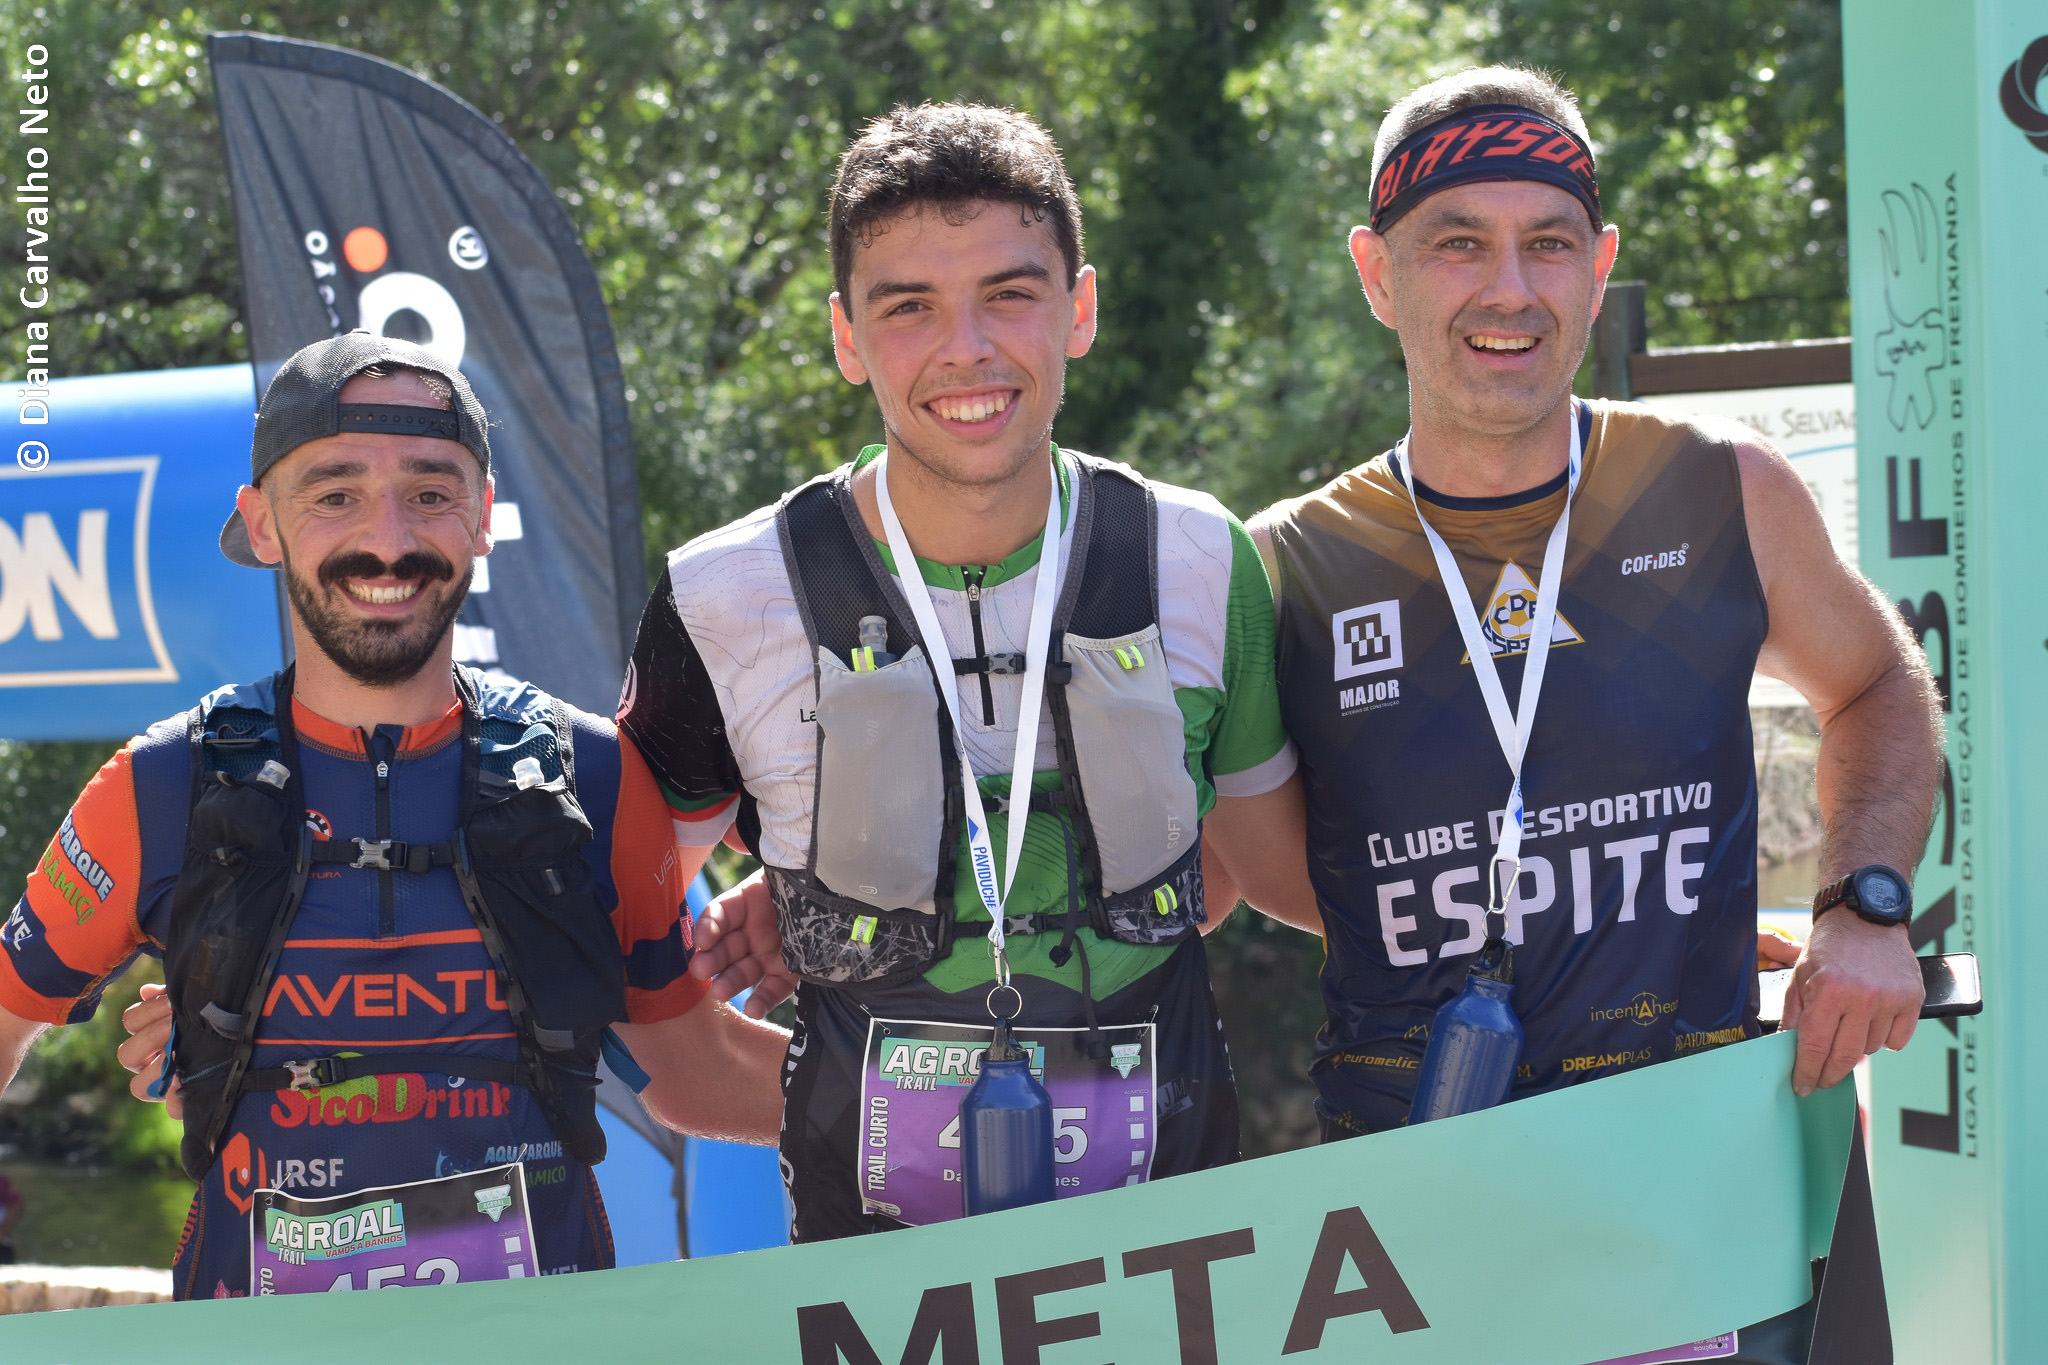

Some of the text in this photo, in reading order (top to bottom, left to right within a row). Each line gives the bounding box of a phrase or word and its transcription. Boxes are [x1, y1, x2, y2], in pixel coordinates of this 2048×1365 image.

[1944, 172, 1963, 366] FREIXIANDA
[1951, 378, 1965, 418] DE
[1951, 431, 1969, 626] BOMBEIROS
[1956, 637, 1970, 679] DE
[1340, 679, 1400, 710] MAJOR
[973, 846, 997, 909] PAVIDUCHE
[1961, 837, 1974, 881] DA
[1376, 826, 1711, 967] ESPITE
[1964, 1032, 1978, 1074] DE
[271, 1072, 511, 1127] SicoDrink
[895, 1074, 938, 1092] TRAIL
[867, 1096, 889, 1191] TRAIL CURTO
[1965, 1087, 1978, 1158] LIGA
[270, 1157, 344, 1189] JRSF
[269, 1206, 404, 1251] AGROAL
[325, 1233, 403, 1258] VAMOS A BANHOS
[278, 1247, 307, 1266] TRAIL
